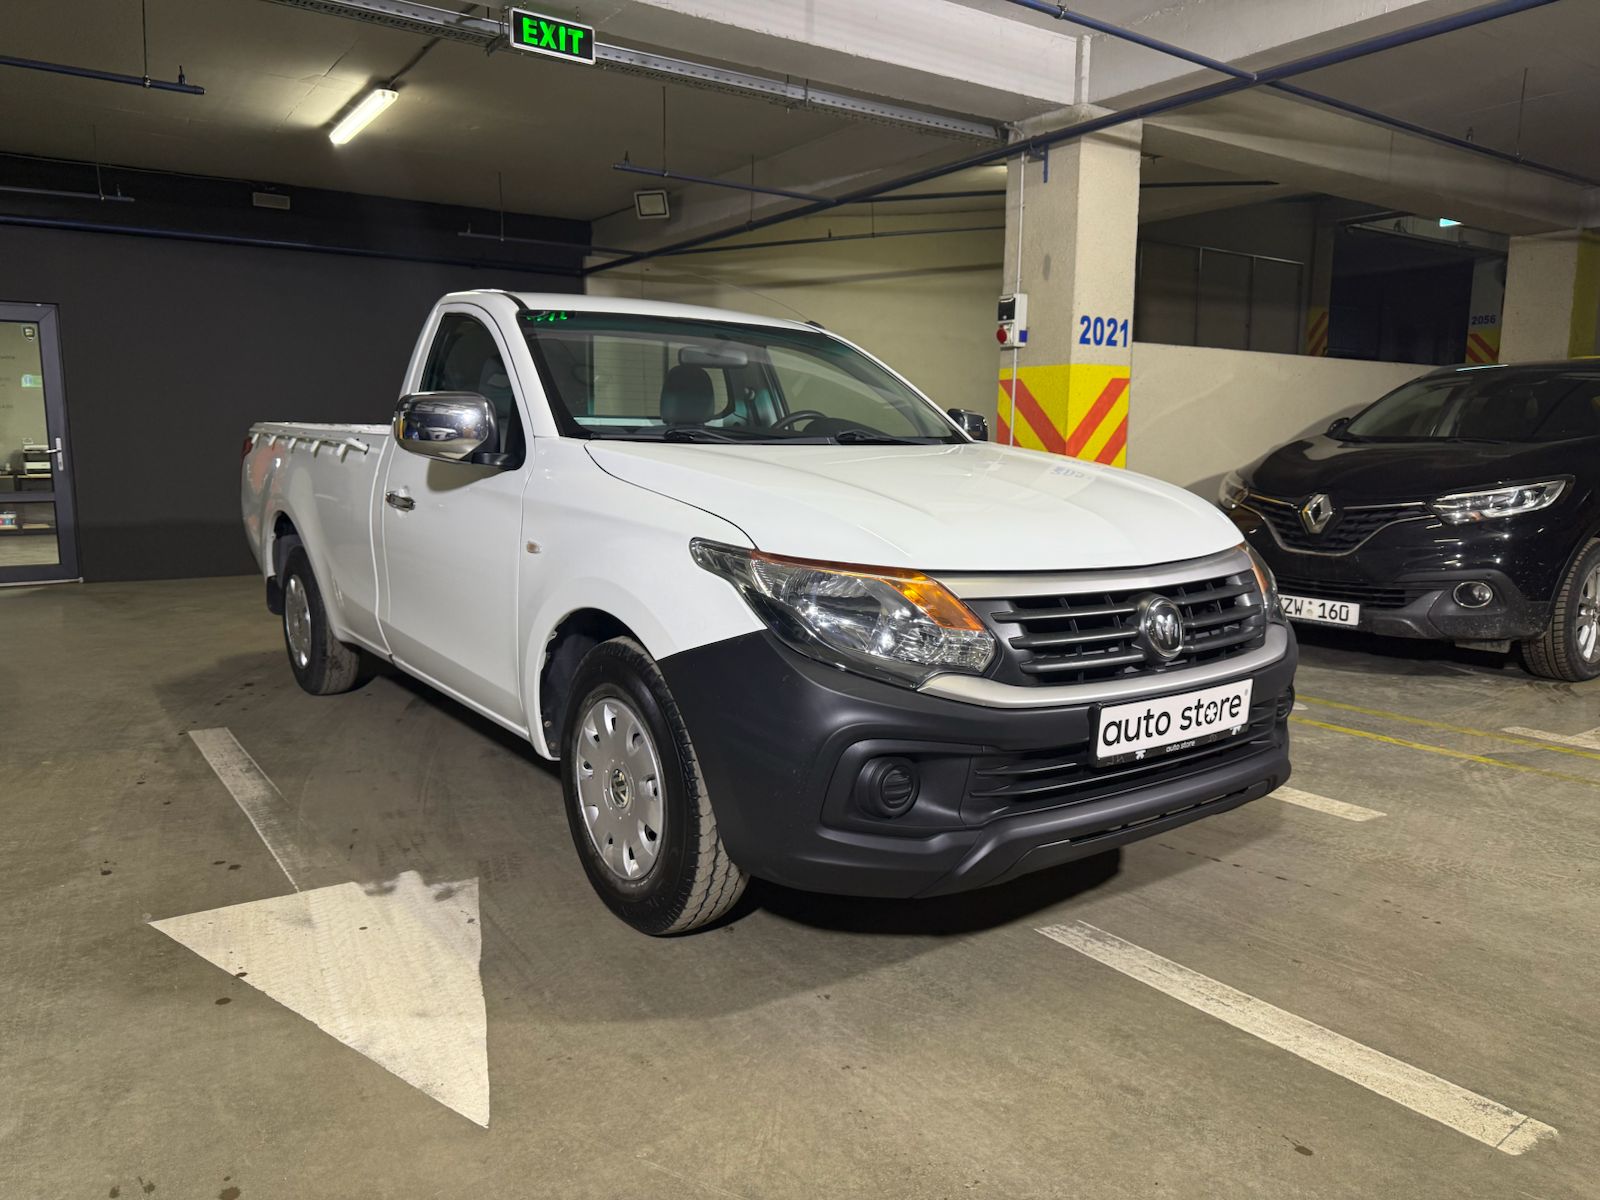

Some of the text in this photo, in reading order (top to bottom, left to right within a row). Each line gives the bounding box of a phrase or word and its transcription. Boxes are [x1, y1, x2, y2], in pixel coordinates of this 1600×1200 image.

[522, 17, 584, 54] EXIT
[1079, 315, 1129, 348] 2021
[1471, 314, 1497, 325] 2056
[1317, 602, 1350, 621] 160
[1102, 694, 1242, 746] auto store
[1165, 740, 1196, 753] auto store
